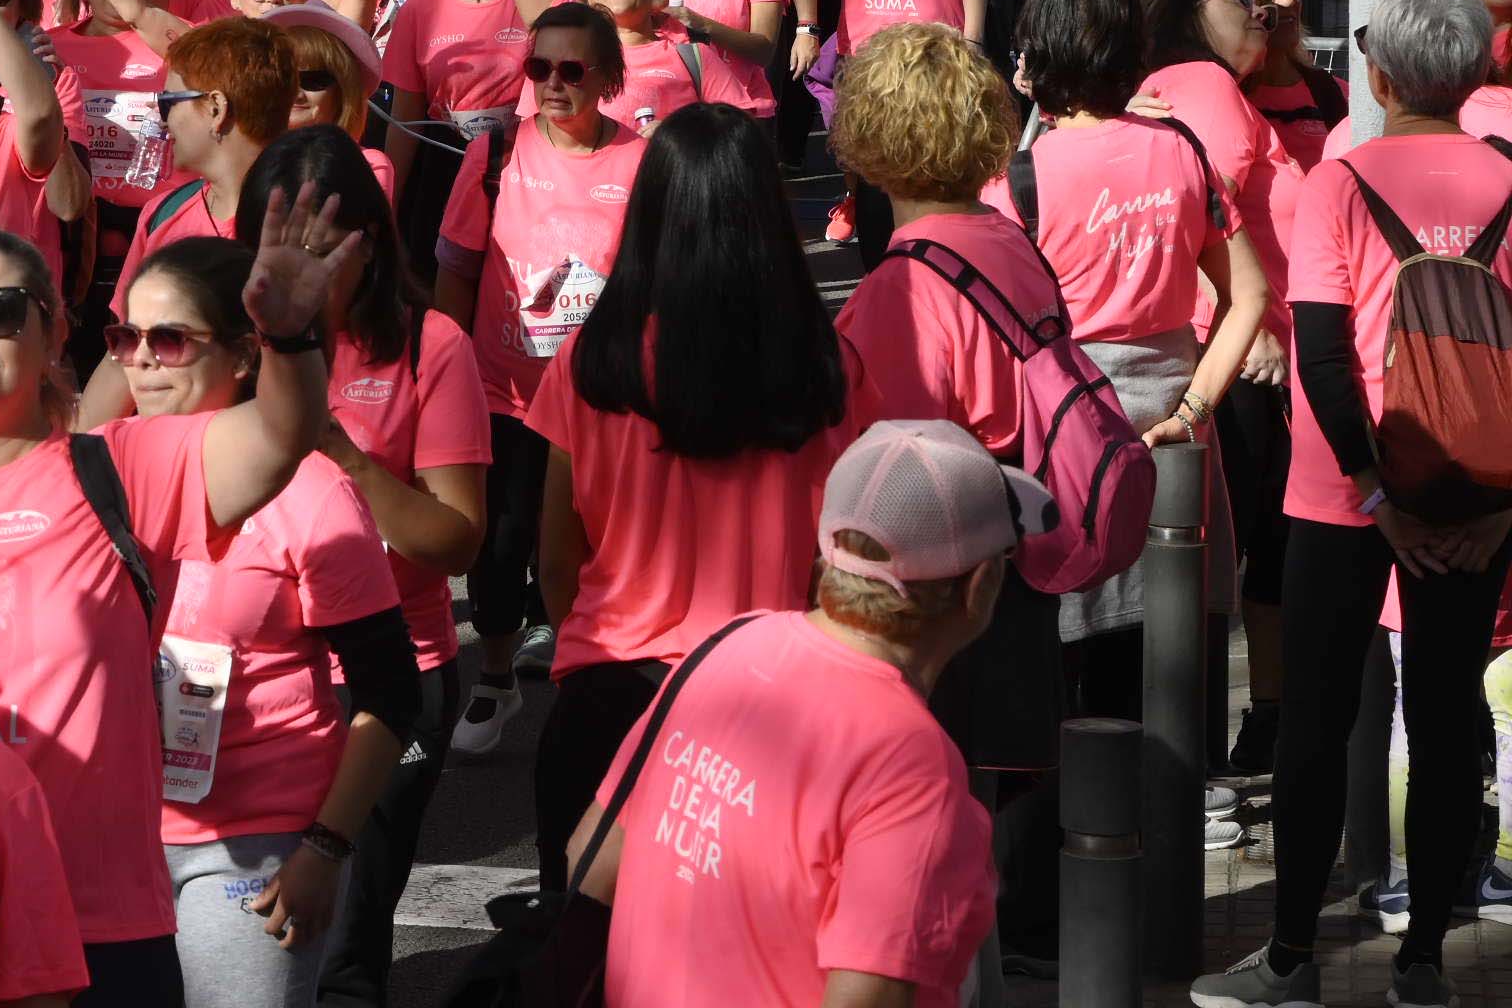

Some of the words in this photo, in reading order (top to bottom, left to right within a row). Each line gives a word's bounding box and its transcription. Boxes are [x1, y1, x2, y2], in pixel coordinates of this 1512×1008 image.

[430, 33, 465, 48] OYSHO
[87, 125, 118, 138] 016
[510, 173, 555, 192] OSHO
[559, 292, 596, 309] 016
[533, 340, 561, 350] OYSH
[182, 661, 216, 674] SUMA
[399, 752, 427, 765] adidas
